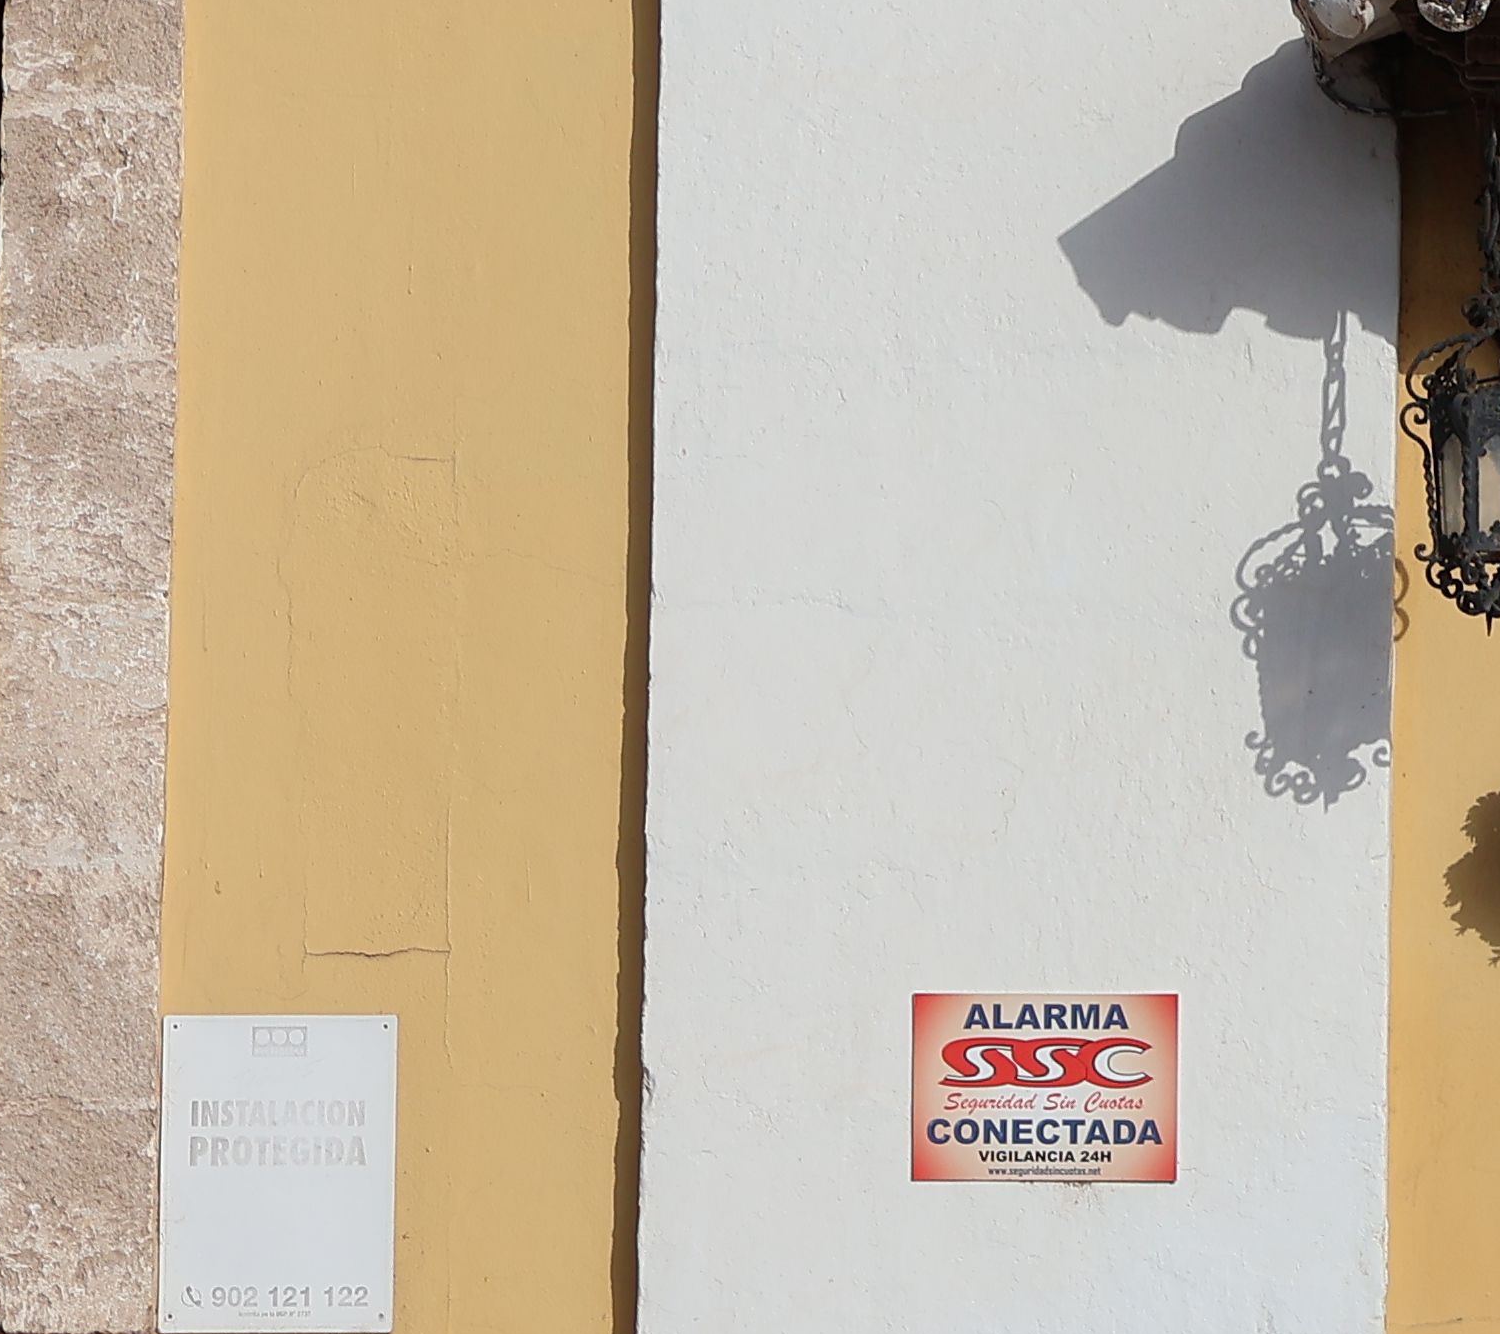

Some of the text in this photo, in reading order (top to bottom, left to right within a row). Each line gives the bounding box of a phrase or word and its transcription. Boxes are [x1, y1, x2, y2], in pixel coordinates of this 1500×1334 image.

[963, 1003, 1129, 1030] ALARMA
[938, 1037, 1153, 1089] SSC
[191, 1100, 366, 1127] INSTALACION
[943, 1091, 1144, 1115] Seguridad Sin Cuotas
[927, 1118, 1163, 1145] CONECTADA
[189, 1136, 367, 1166] PROTEGIDA
[979, 1150, 1112, 1164] VIGILANCIA 24H
[211, 1286, 369, 1308] 902 121 122
